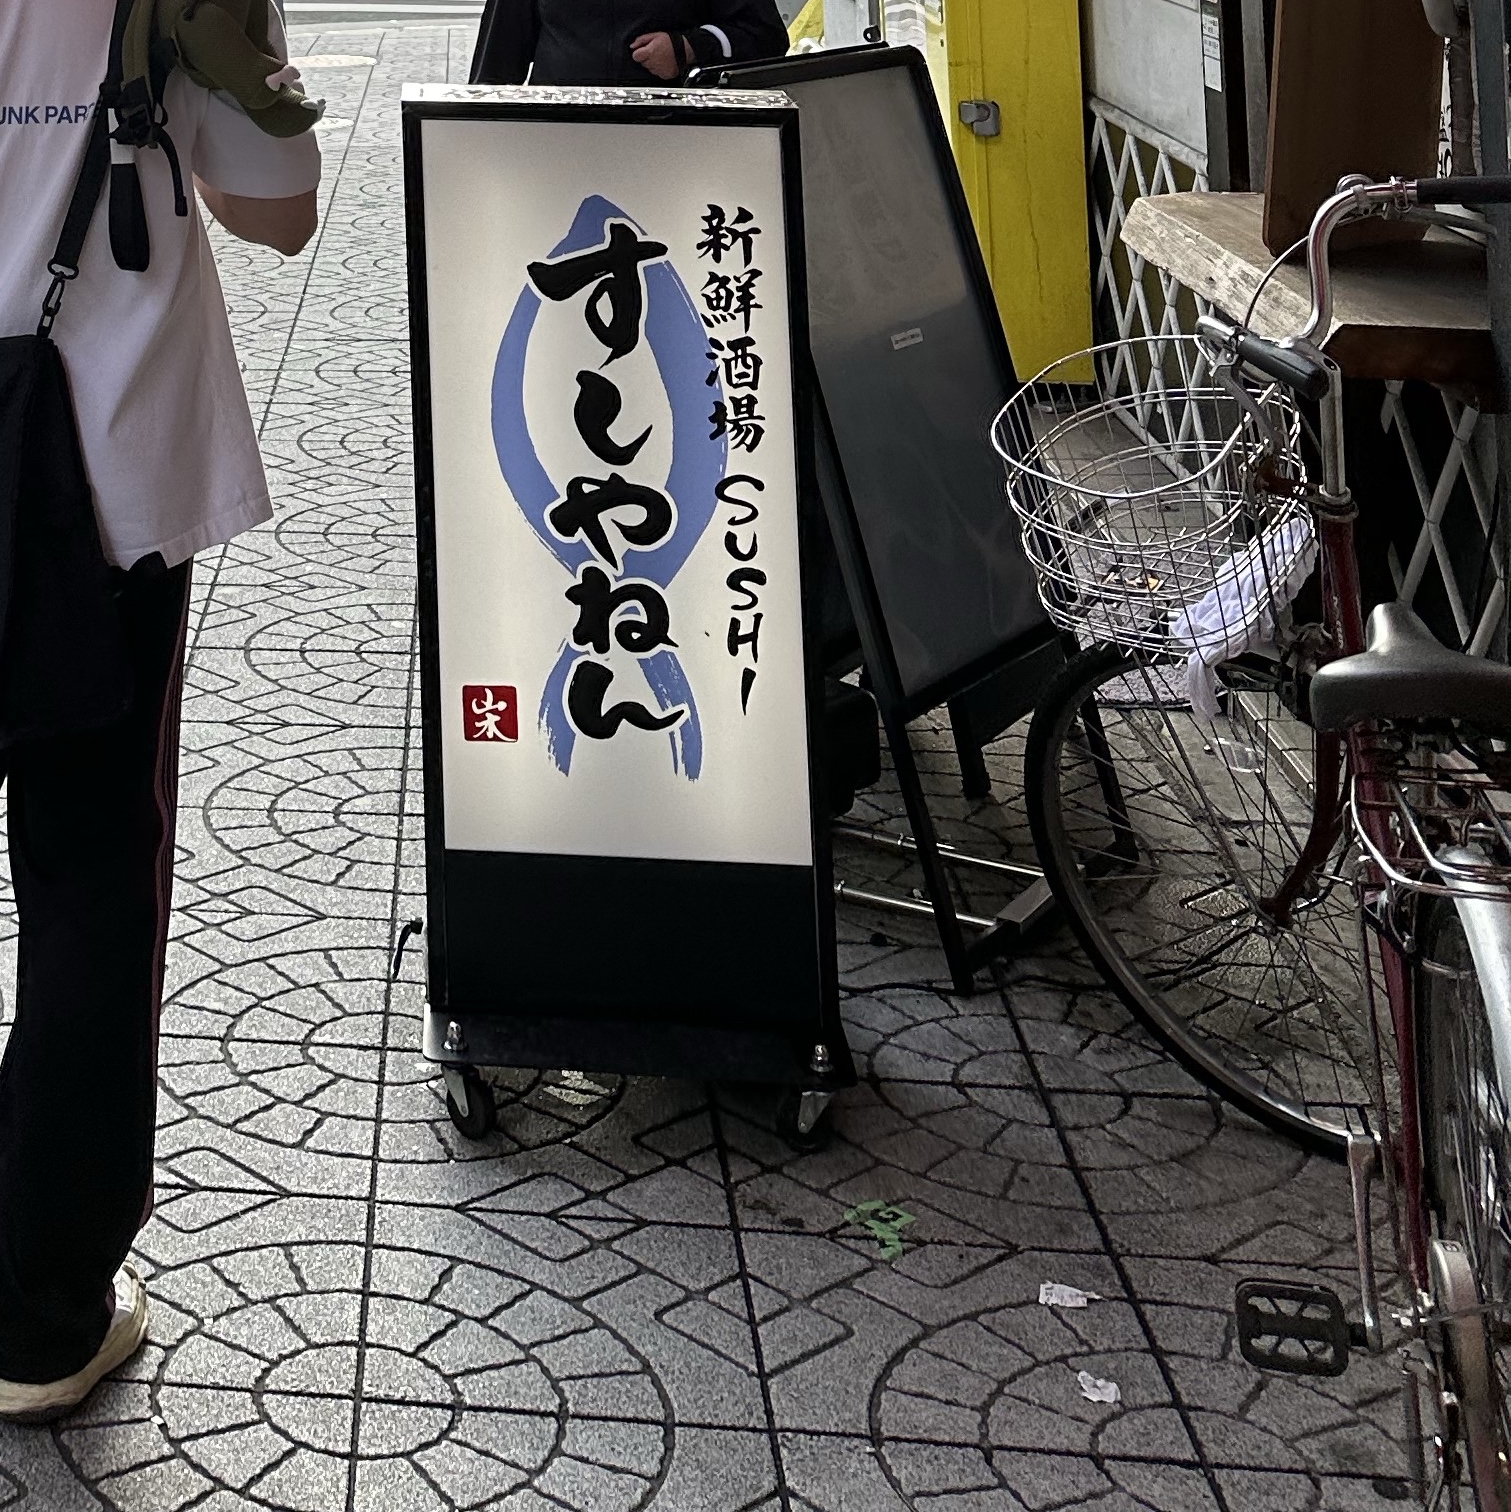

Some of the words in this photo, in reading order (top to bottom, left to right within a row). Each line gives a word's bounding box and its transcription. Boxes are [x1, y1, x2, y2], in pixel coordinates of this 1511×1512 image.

[695, 203, 767, 454] 新鮮酒場
[527, 222, 687, 740] すしやねん
[714, 475, 767, 716] SUSHI
